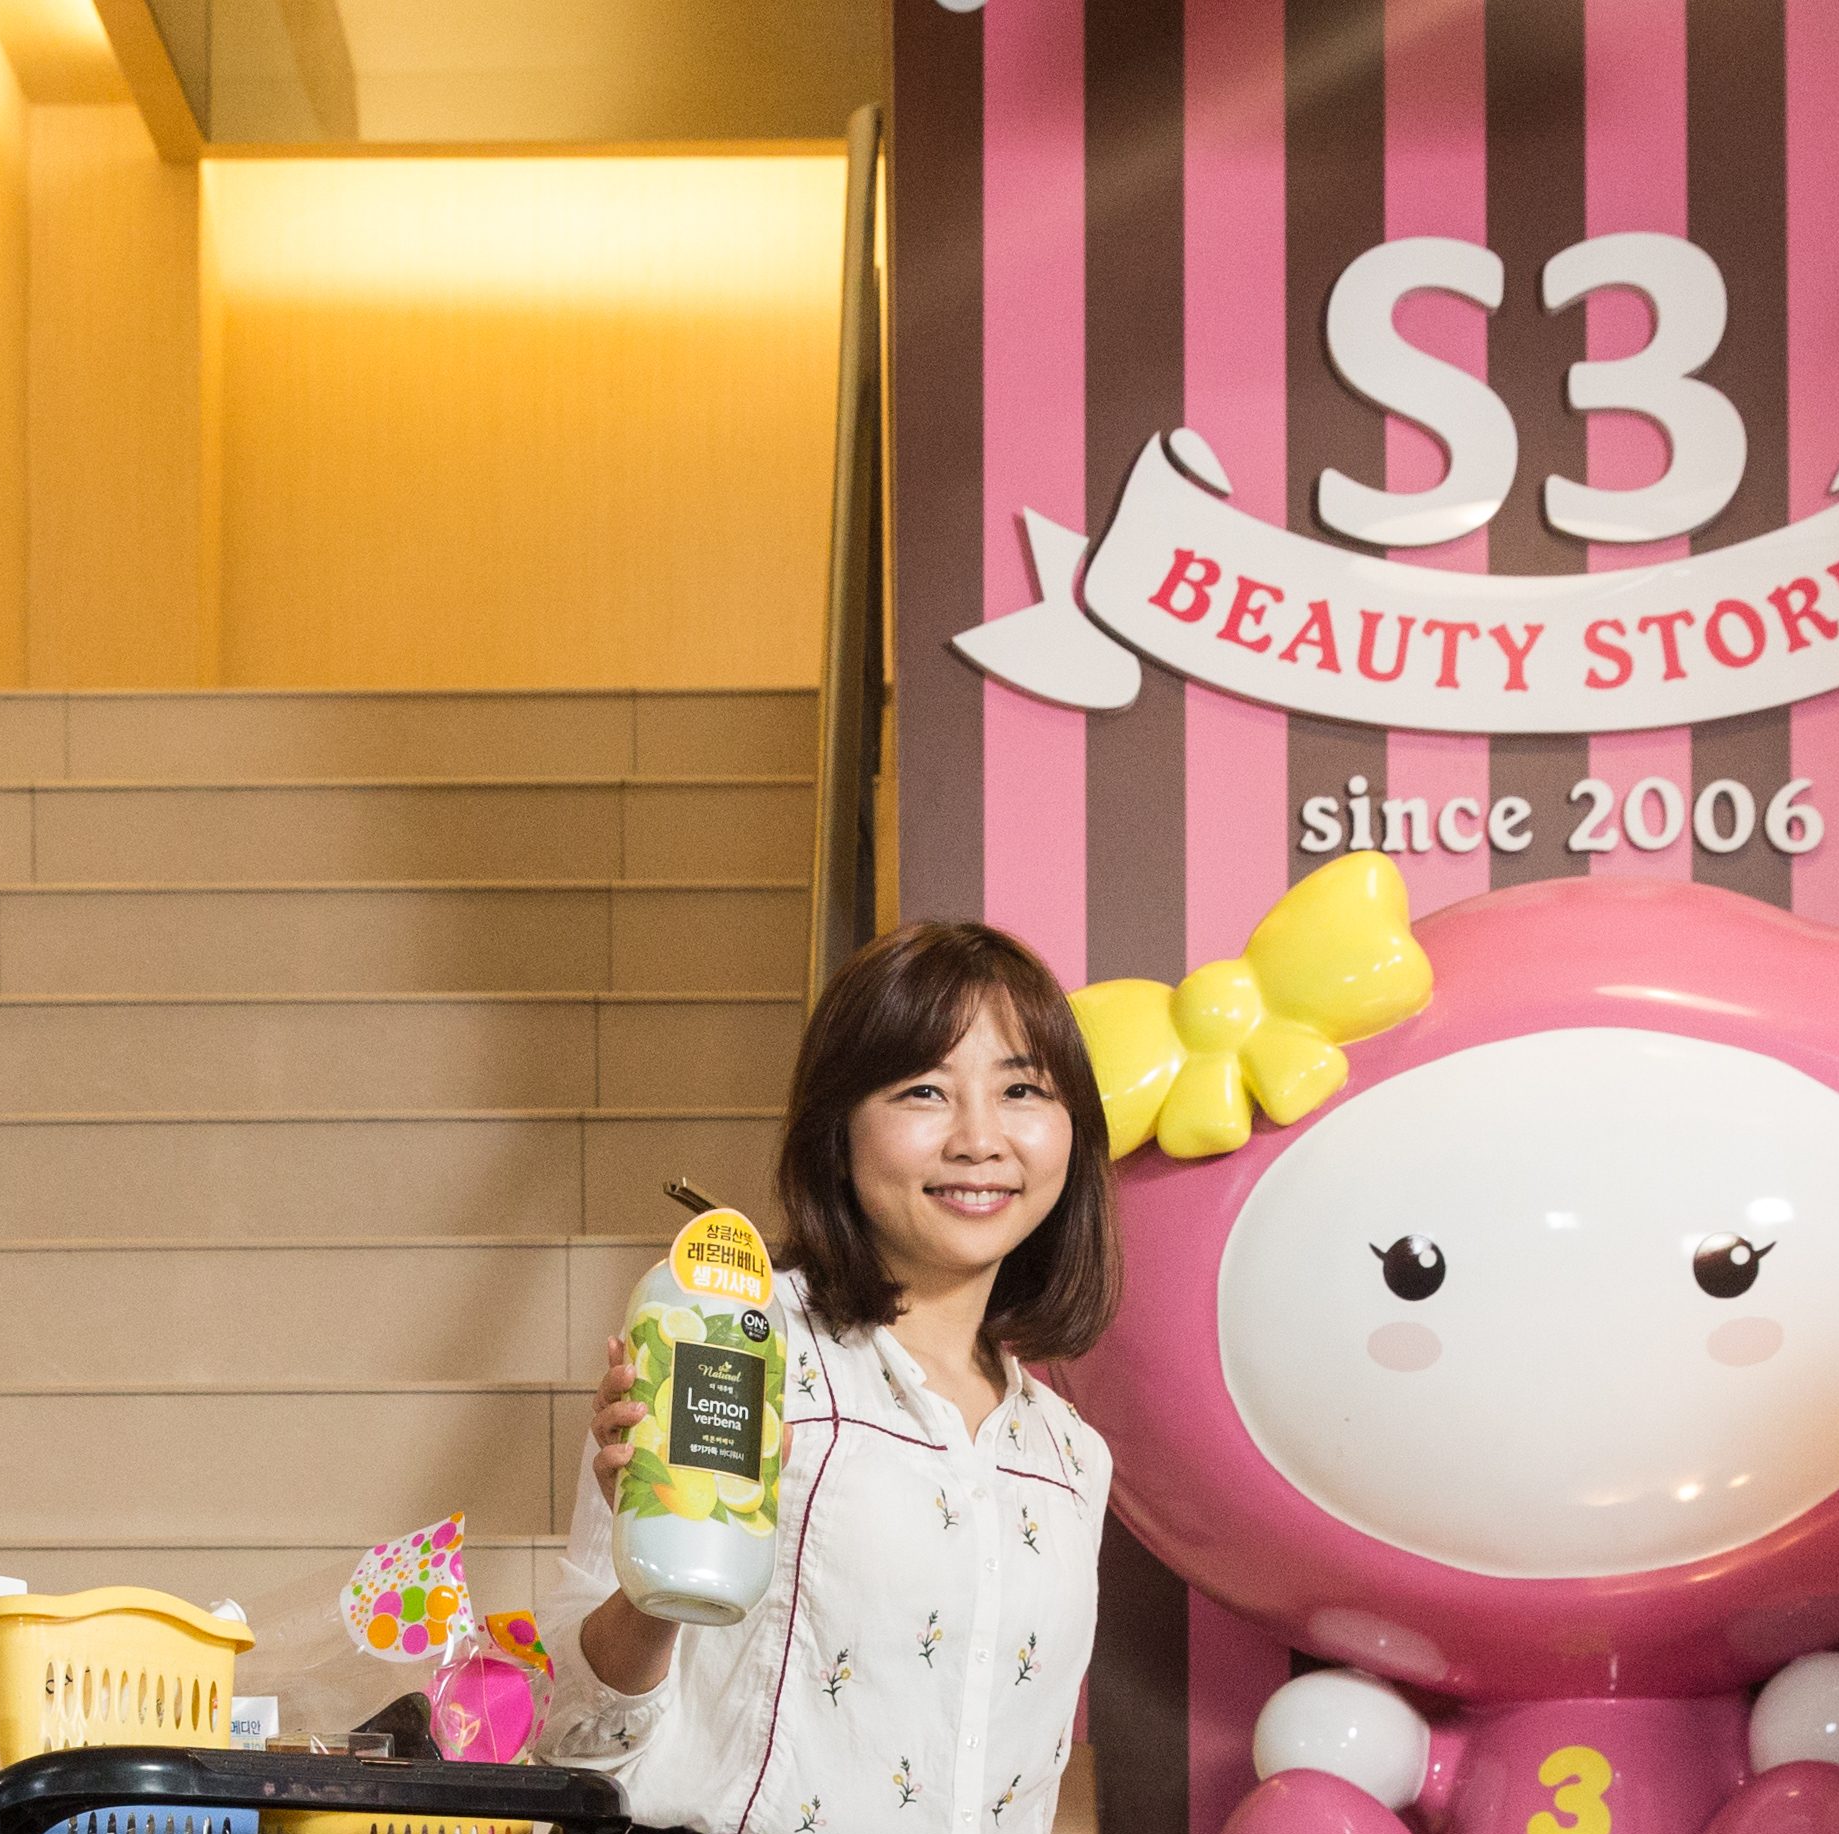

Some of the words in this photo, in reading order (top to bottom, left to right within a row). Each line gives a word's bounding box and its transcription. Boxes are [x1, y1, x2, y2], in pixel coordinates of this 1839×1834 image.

[1316, 231, 1749, 547] S3
[1148, 546, 1545, 693] BEAUTY
[1300, 775, 1533, 855] since
[1568, 777, 1825, 855] 2006
[706, 1224, 754, 1250] 상큼산뜻
[688, 1243, 766, 1277] 레몬버베나
[692, 1265, 762, 1300] 생기샤워
[744, 1314, 768, 1331] ON:
[698, 1364, 742, 1383] Natural
[686, 1387, 749, 1420] Lemon
[693, 1413, 742, 1431] verbena
